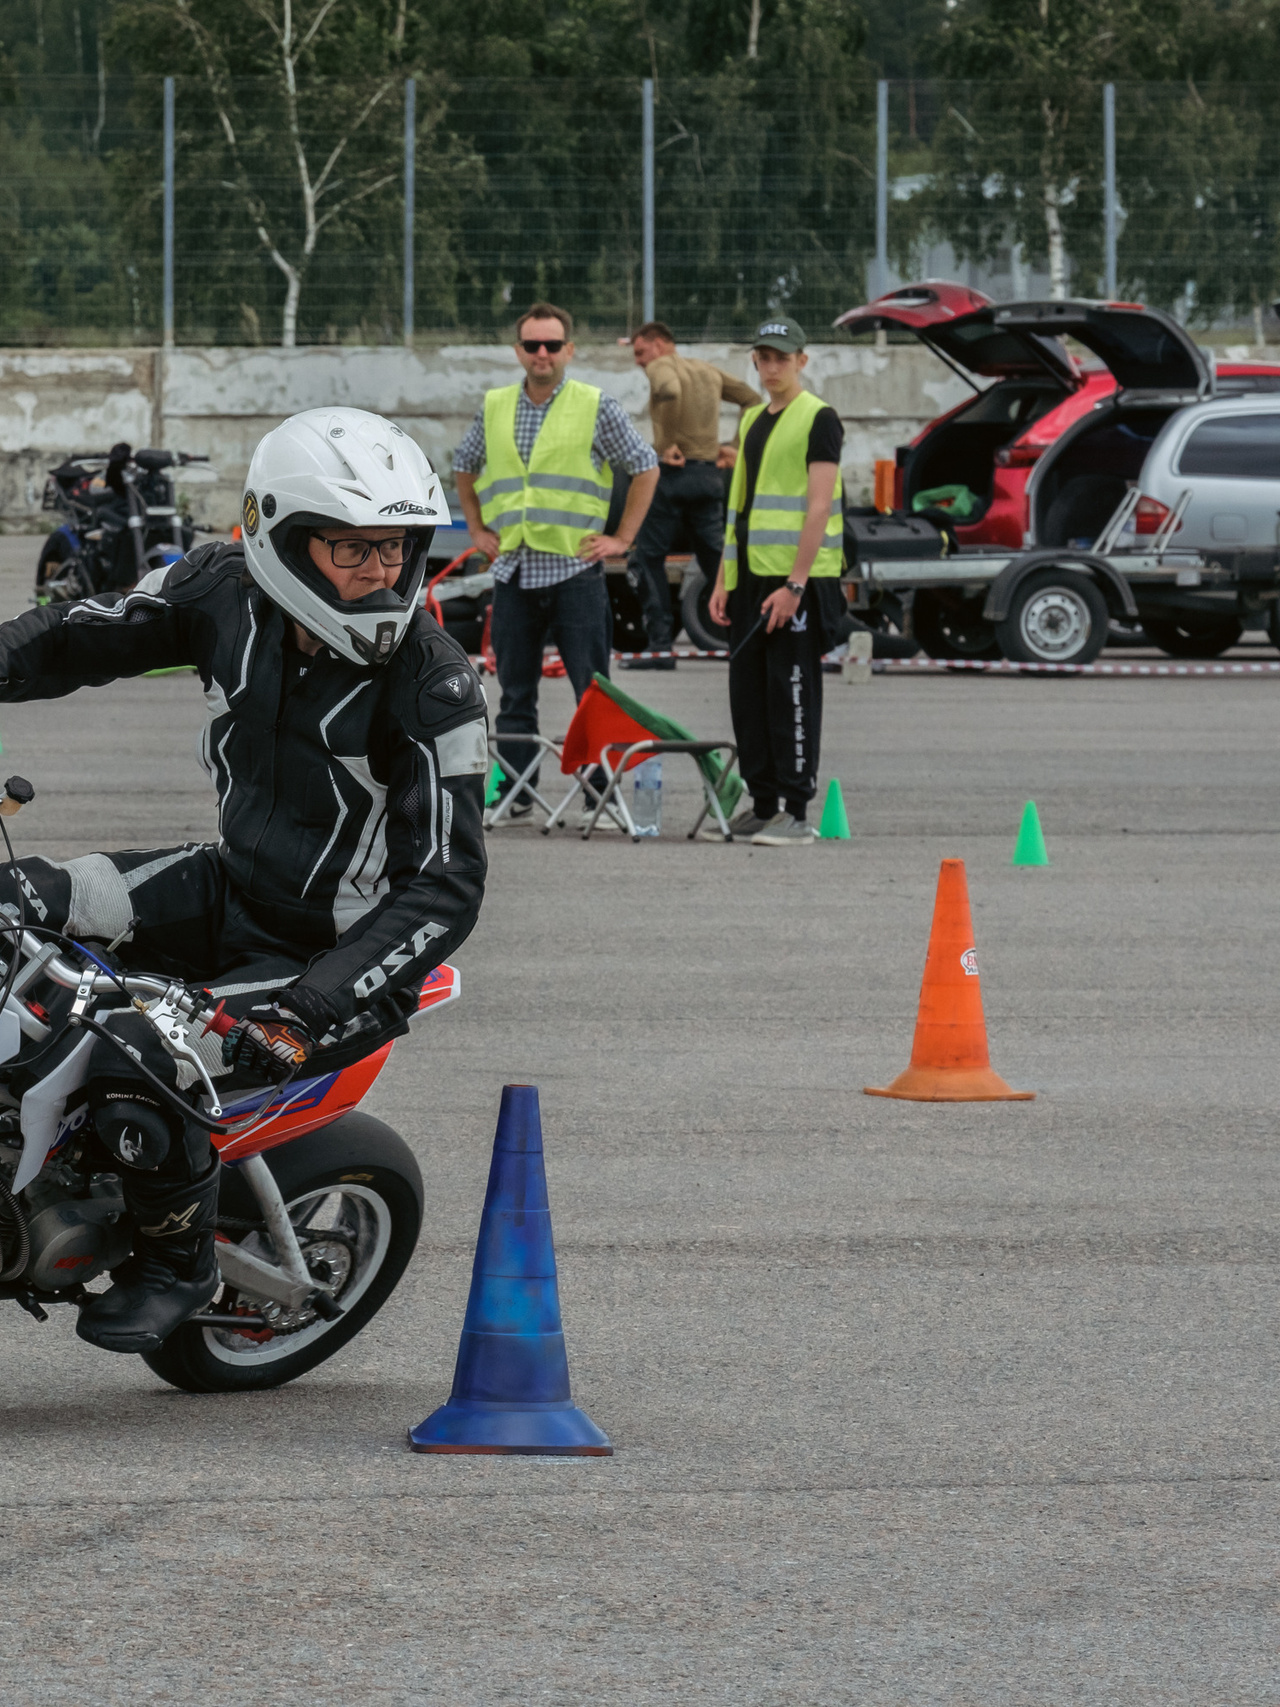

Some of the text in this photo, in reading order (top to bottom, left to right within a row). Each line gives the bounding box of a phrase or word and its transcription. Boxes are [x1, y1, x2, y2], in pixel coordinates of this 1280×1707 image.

[245, 497, 256, 527] 10
[387, 500, 433, 516] Nitro
[106, 1092, 161, 1107] KOMINE RACING
